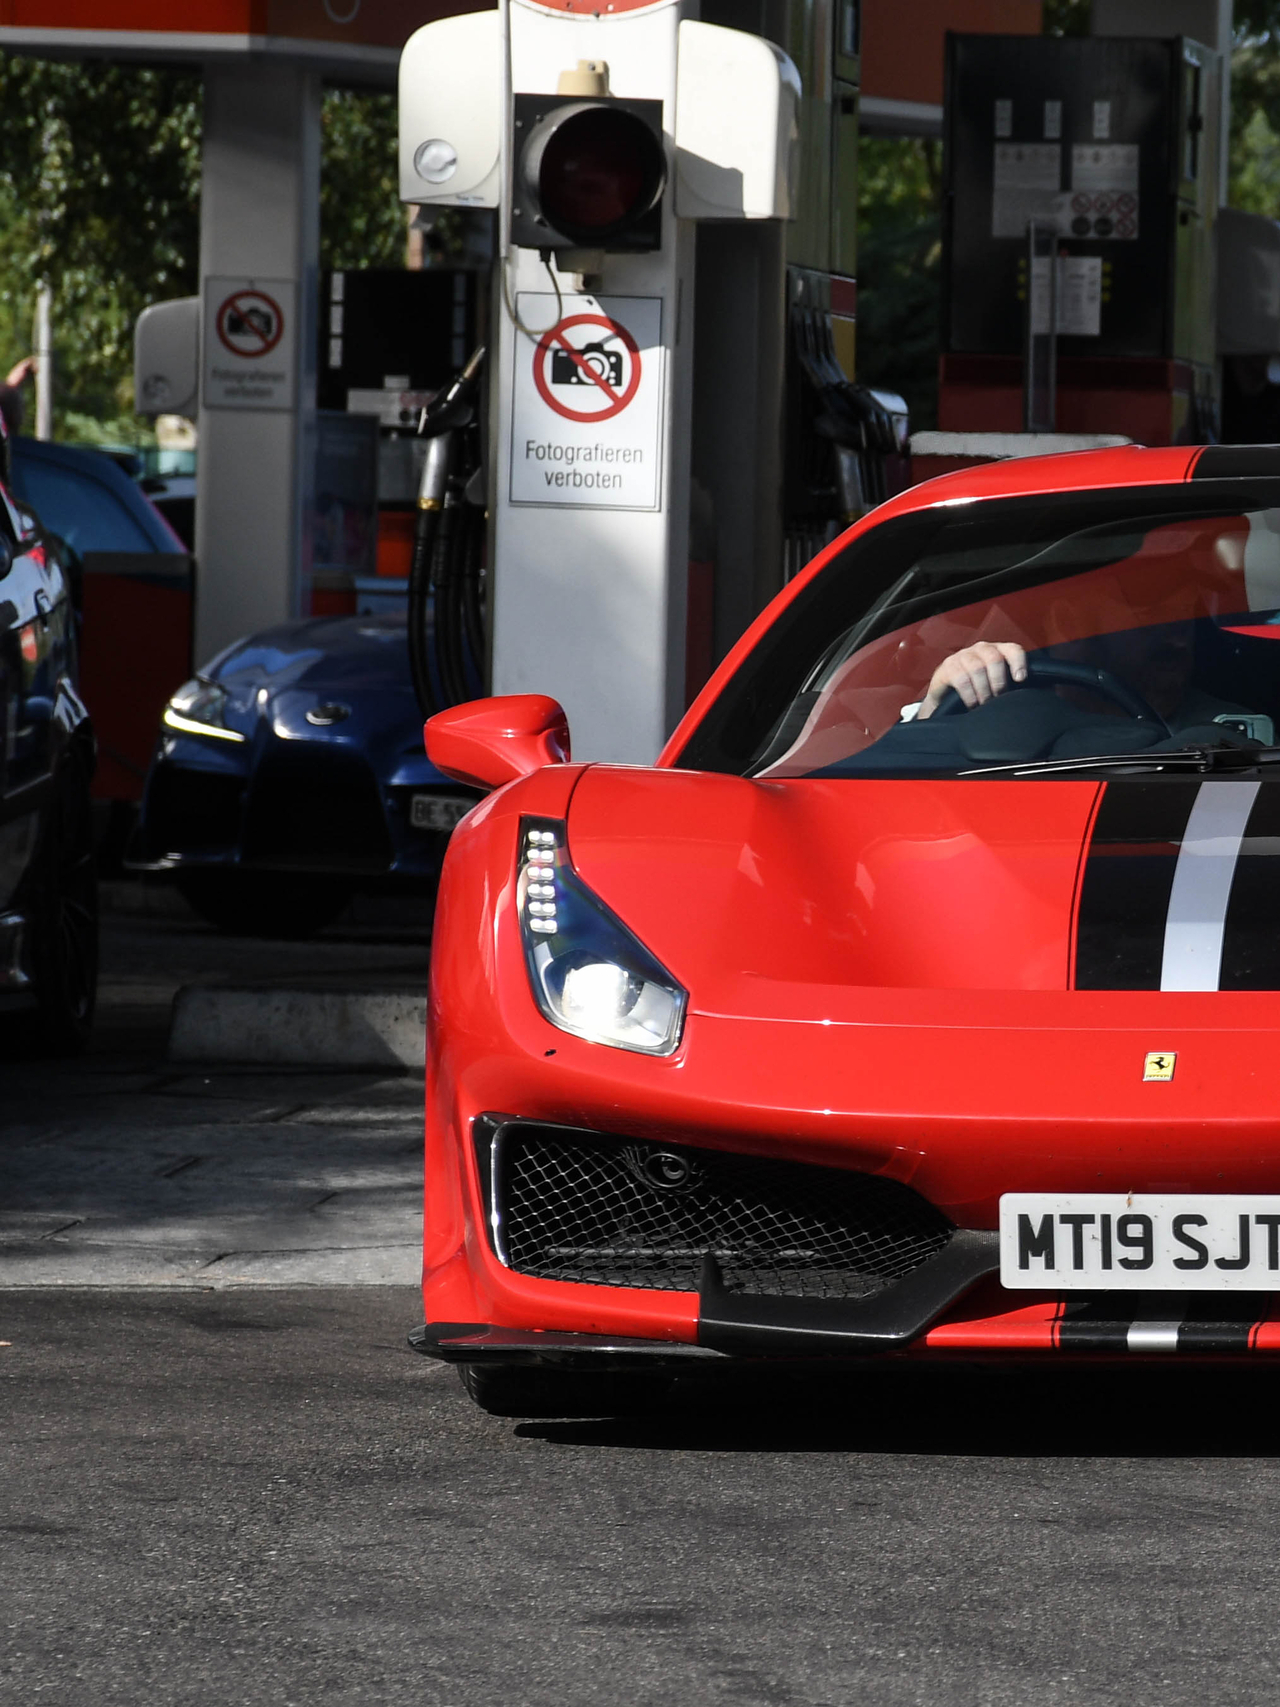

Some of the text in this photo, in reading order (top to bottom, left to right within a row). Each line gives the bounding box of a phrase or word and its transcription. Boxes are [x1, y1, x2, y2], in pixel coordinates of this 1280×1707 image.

[525, 440, 643, 465] Fotografieren
[544, 469, 622, 488] verboten
[1017, 1213, 1154, 1270] MT19
